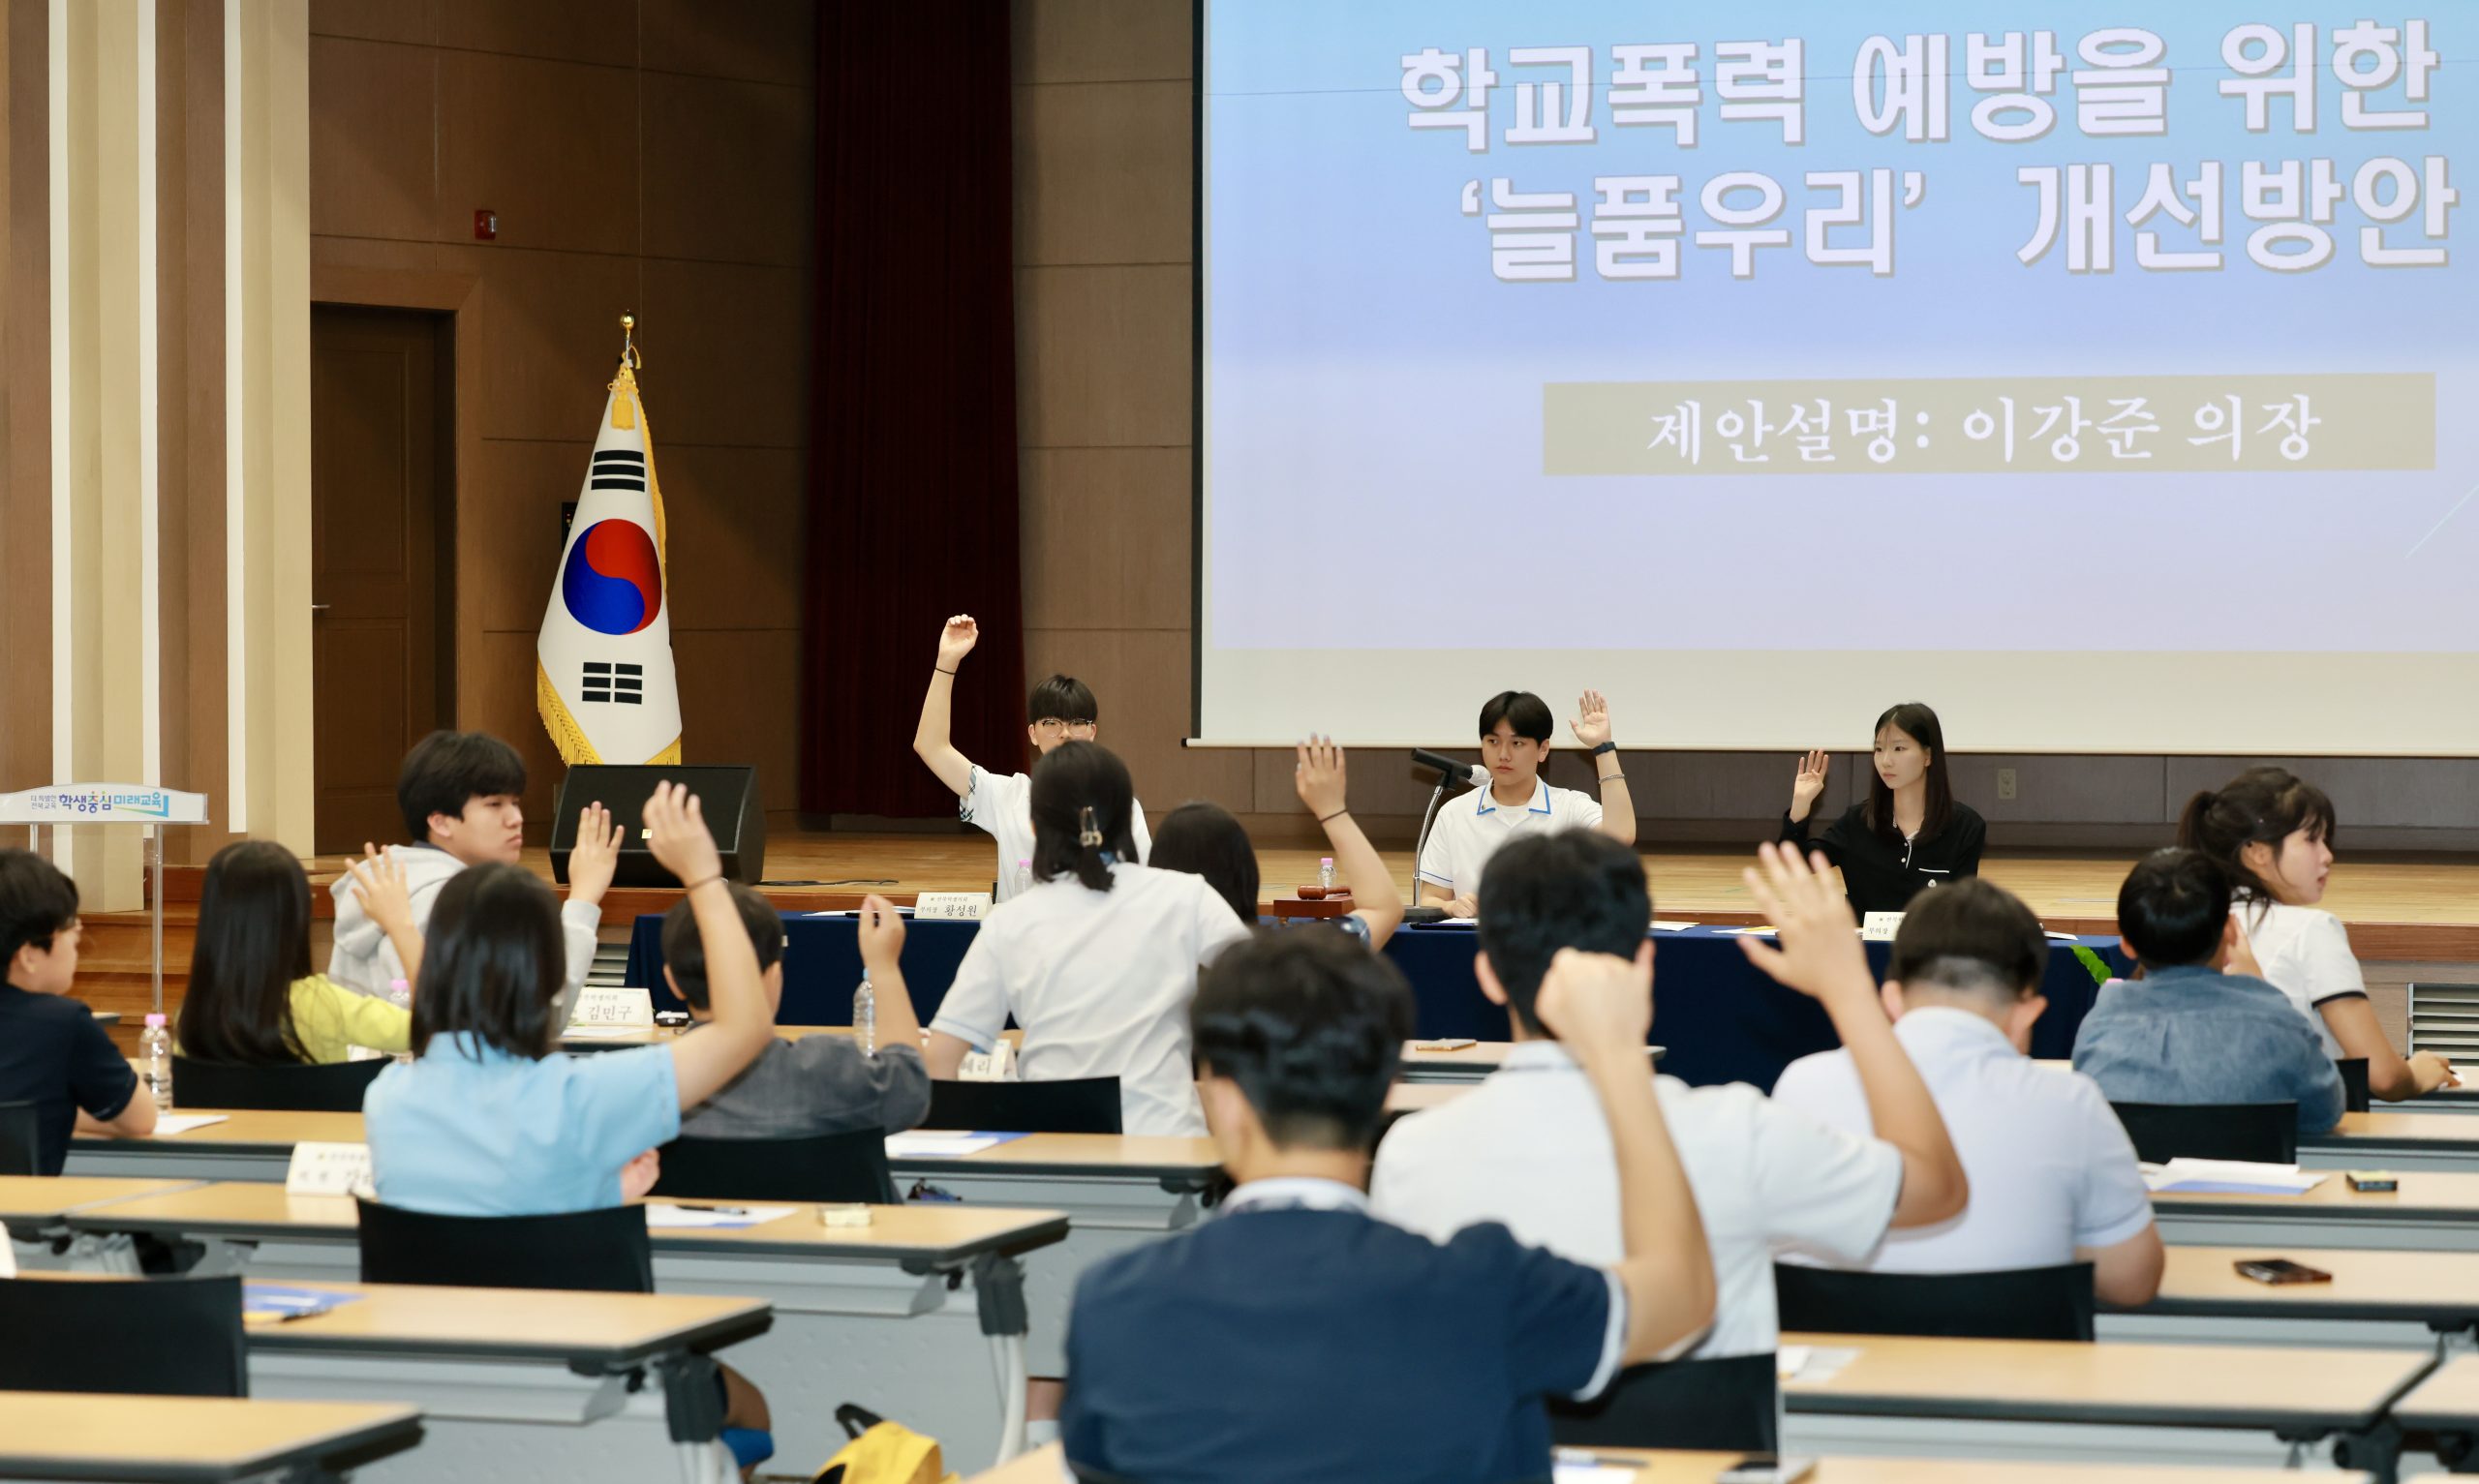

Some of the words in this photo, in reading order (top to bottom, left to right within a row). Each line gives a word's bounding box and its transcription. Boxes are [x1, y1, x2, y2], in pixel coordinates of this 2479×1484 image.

[1399, 37, 1806, 152] 학교폭력
[1851, 25, 2171, 143] 예방을
[2218, 17, 2440, 133] 위한
[2015, 155, 2460, 274] 개선방안
[1646, 397, 1932, 467] 제안설명:
[1962, 392, 2162, 464] 이강준
[2186, 392, 2323, 462] 의장
[59, 791, 111, 813] 학생중심
[113, 791, 162, 809] 미래교육
[945, 905, 976, 917] 황성원
[588, 1005, 631, 1020] 김민구
